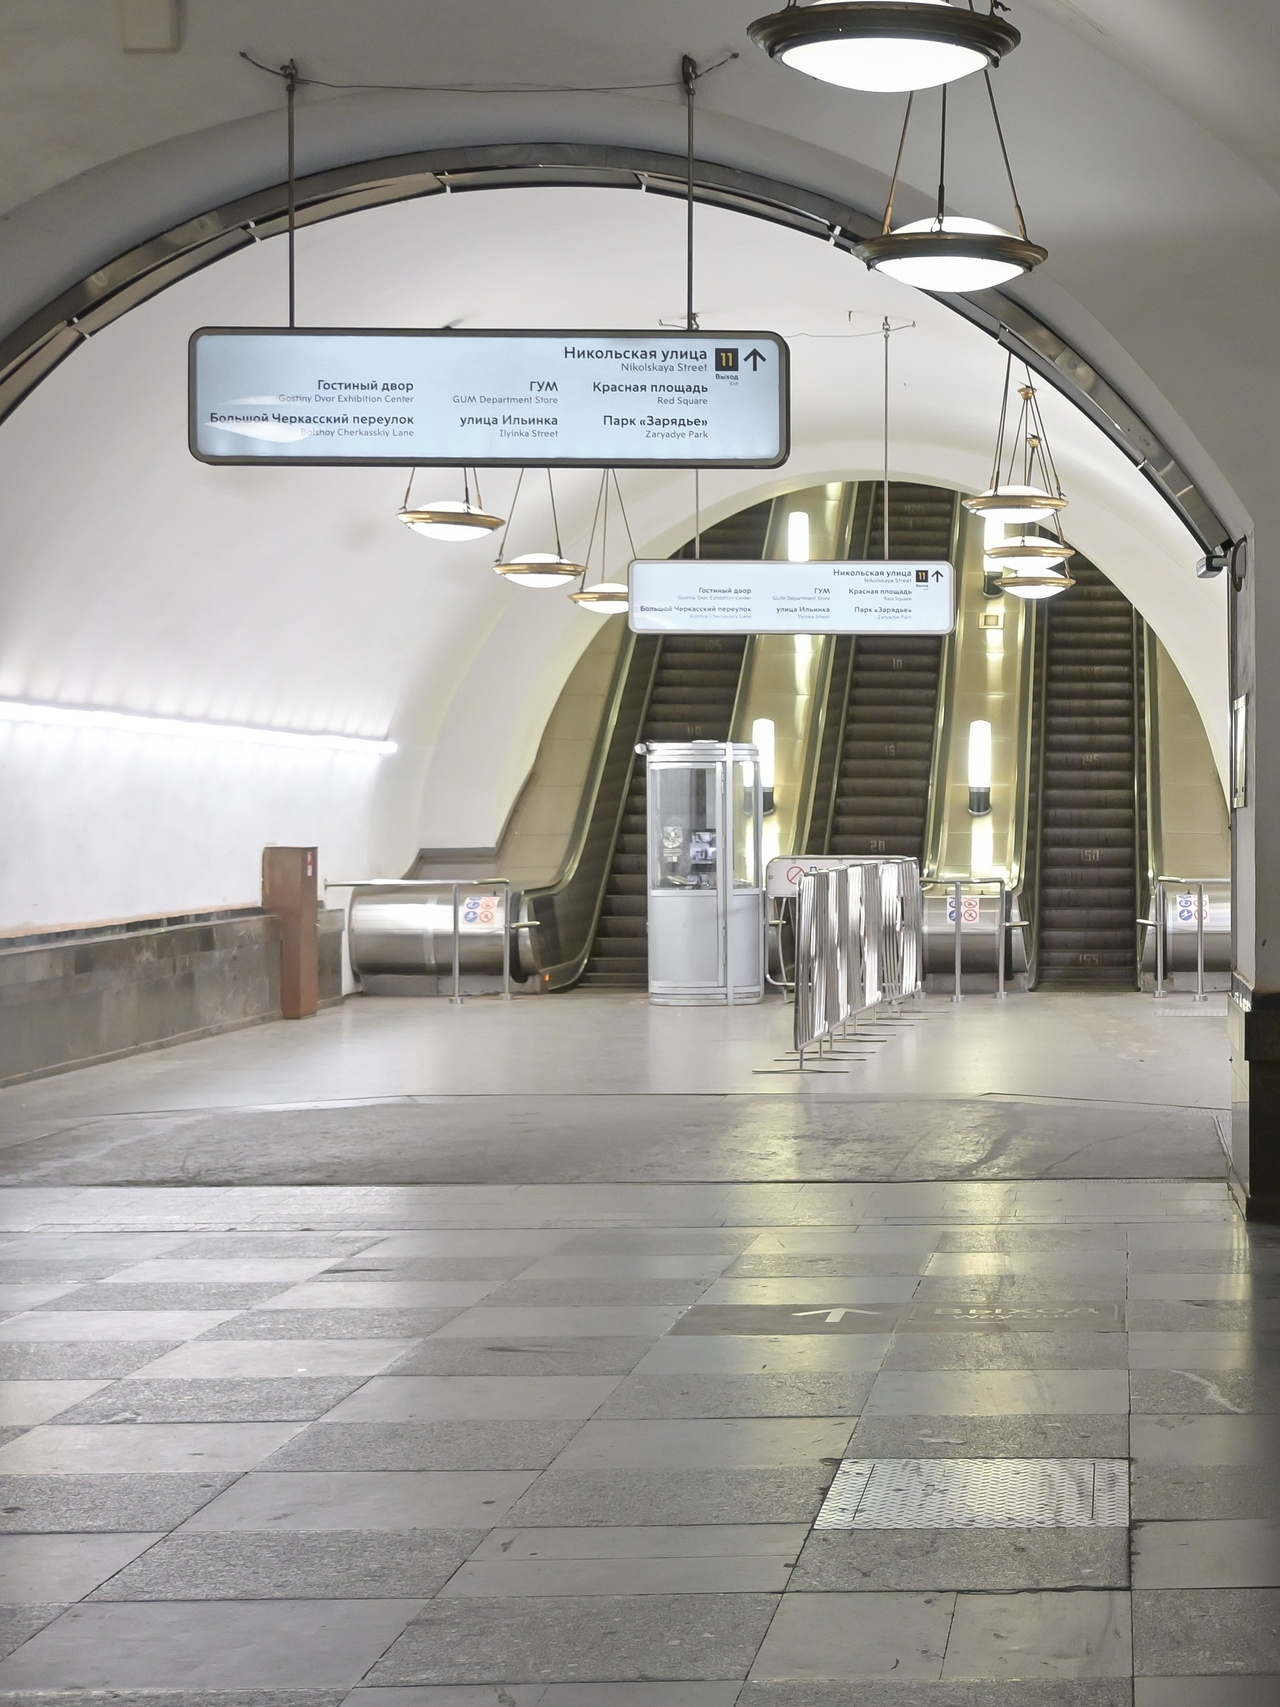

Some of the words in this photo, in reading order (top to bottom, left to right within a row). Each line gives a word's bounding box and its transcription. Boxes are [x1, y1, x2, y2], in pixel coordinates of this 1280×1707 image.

[564, 346, 657, 360] Никольская
[661, 349, 707, 362] улица
[720, 352, 733, 367] 11
[620, 362, 674, 374] Nikolskaya
[677, 362, 707, 372] Street
[715, 373, 739, 381] Выход
[317, 379, 379, 391] Гостиный
[381, 382, 414, 393] двор
[529, 381, 559, 392] ГУМ
[592, 382, 647, 395] Красная
[650, 384, 708, 396] площадь
[279, 394, 313, 405] Gostiny
[315, 394, 335, 403] Dvor
[338, 394, 382, 403] Exhibition
[384, 395, 414, 403] Center
[452, 395, 477, 404] GUM
[479, 395, 532, 406] Department
[534, 395, 558, 404] Store
[657, 396, 674, 405] Red
[677, 396, 708, 407] Square
[210, 412, 269, 424] Большой
[272, 412, 349, 427] Черкасский
[352, 414, 414, 427] переулок
[460, 416, 498, 428] улица
[502, 414, 558, 427] Ильинка
[603, 415, 636, 428] Парк
[640, 415, 708, 429] «Зарядье»
[337, 428, 390, 438] Cherkasskiy
[392, 429, 414, 437] Lane
[499, 429, 529, 440] Ilyinka
[532, 429, 558, 438] Street
[645, 429, 686, 441] Zaryadye
[689, 430, 708, 439] Park
[833, 569, 884, 577] Никольская
[848, 588, 879, 596] Красная
[880, 588, 912, 596] площадь
[640, 605, 673, 613] Большой
[674, 605, 717, 614] Черкасский
[854, 606, 872, 614] Парк
